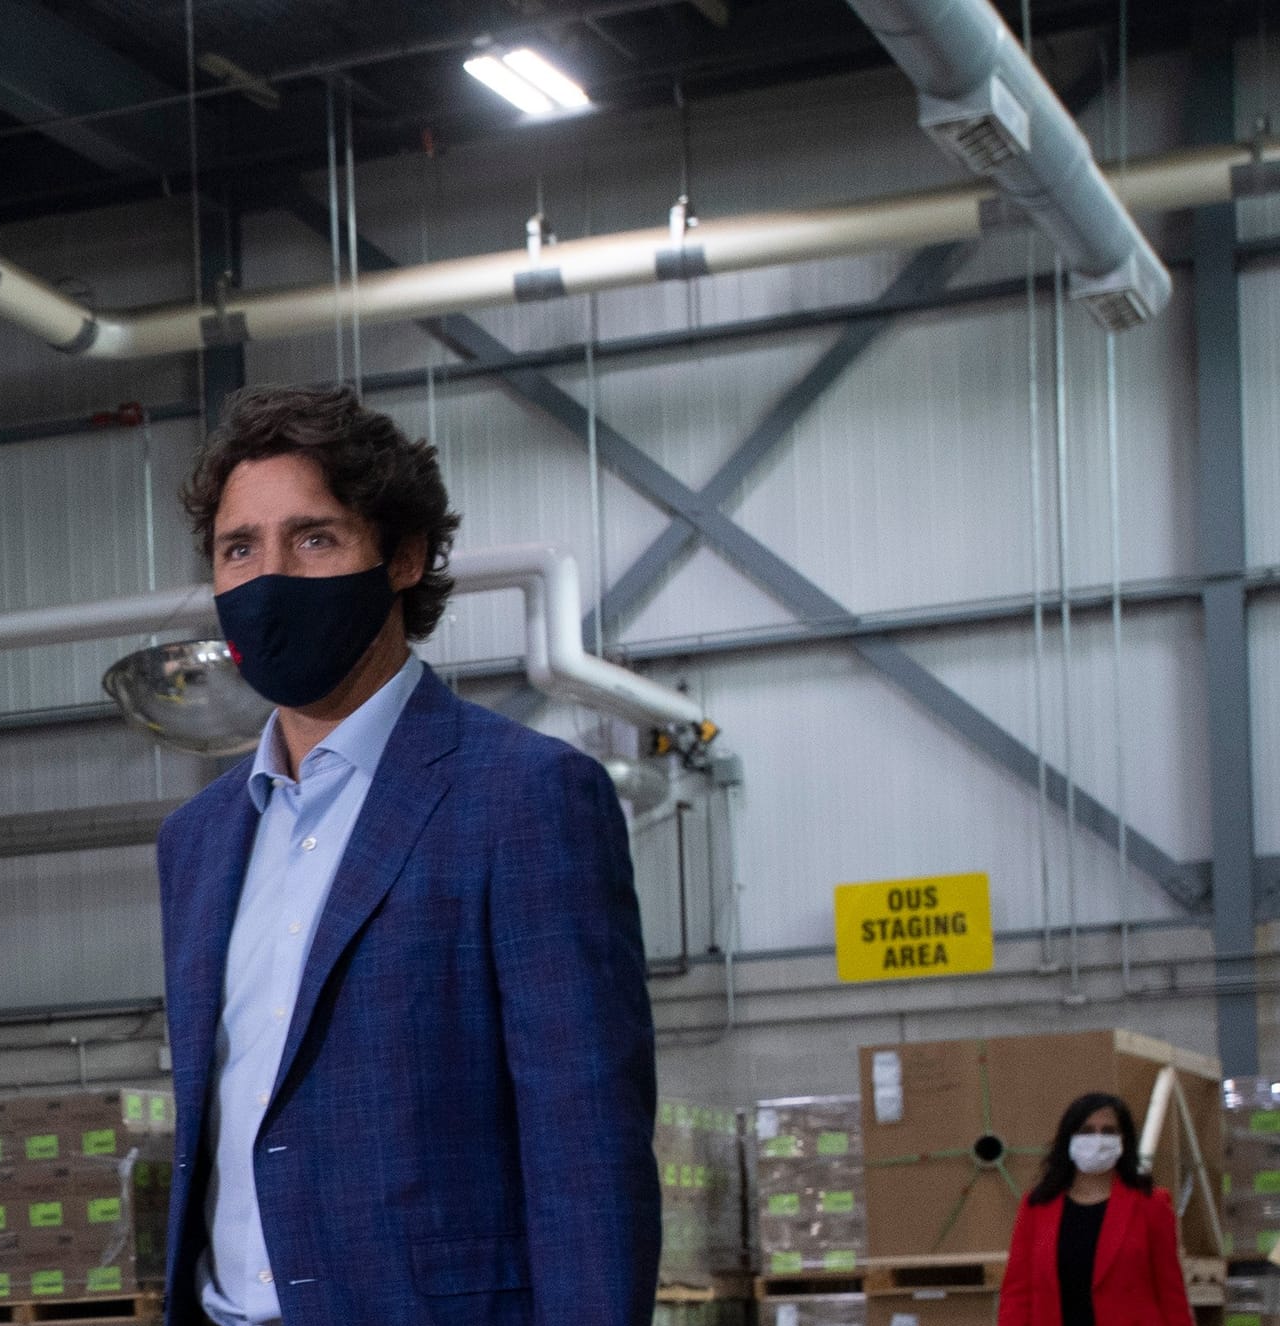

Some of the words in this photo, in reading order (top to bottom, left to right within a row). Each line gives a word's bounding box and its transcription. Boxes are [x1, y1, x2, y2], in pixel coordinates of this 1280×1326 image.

[887, 886, 938, 912] OUS
[861, 912, 967, 942] STAGING
[883, 942, 948, 970] AREA
